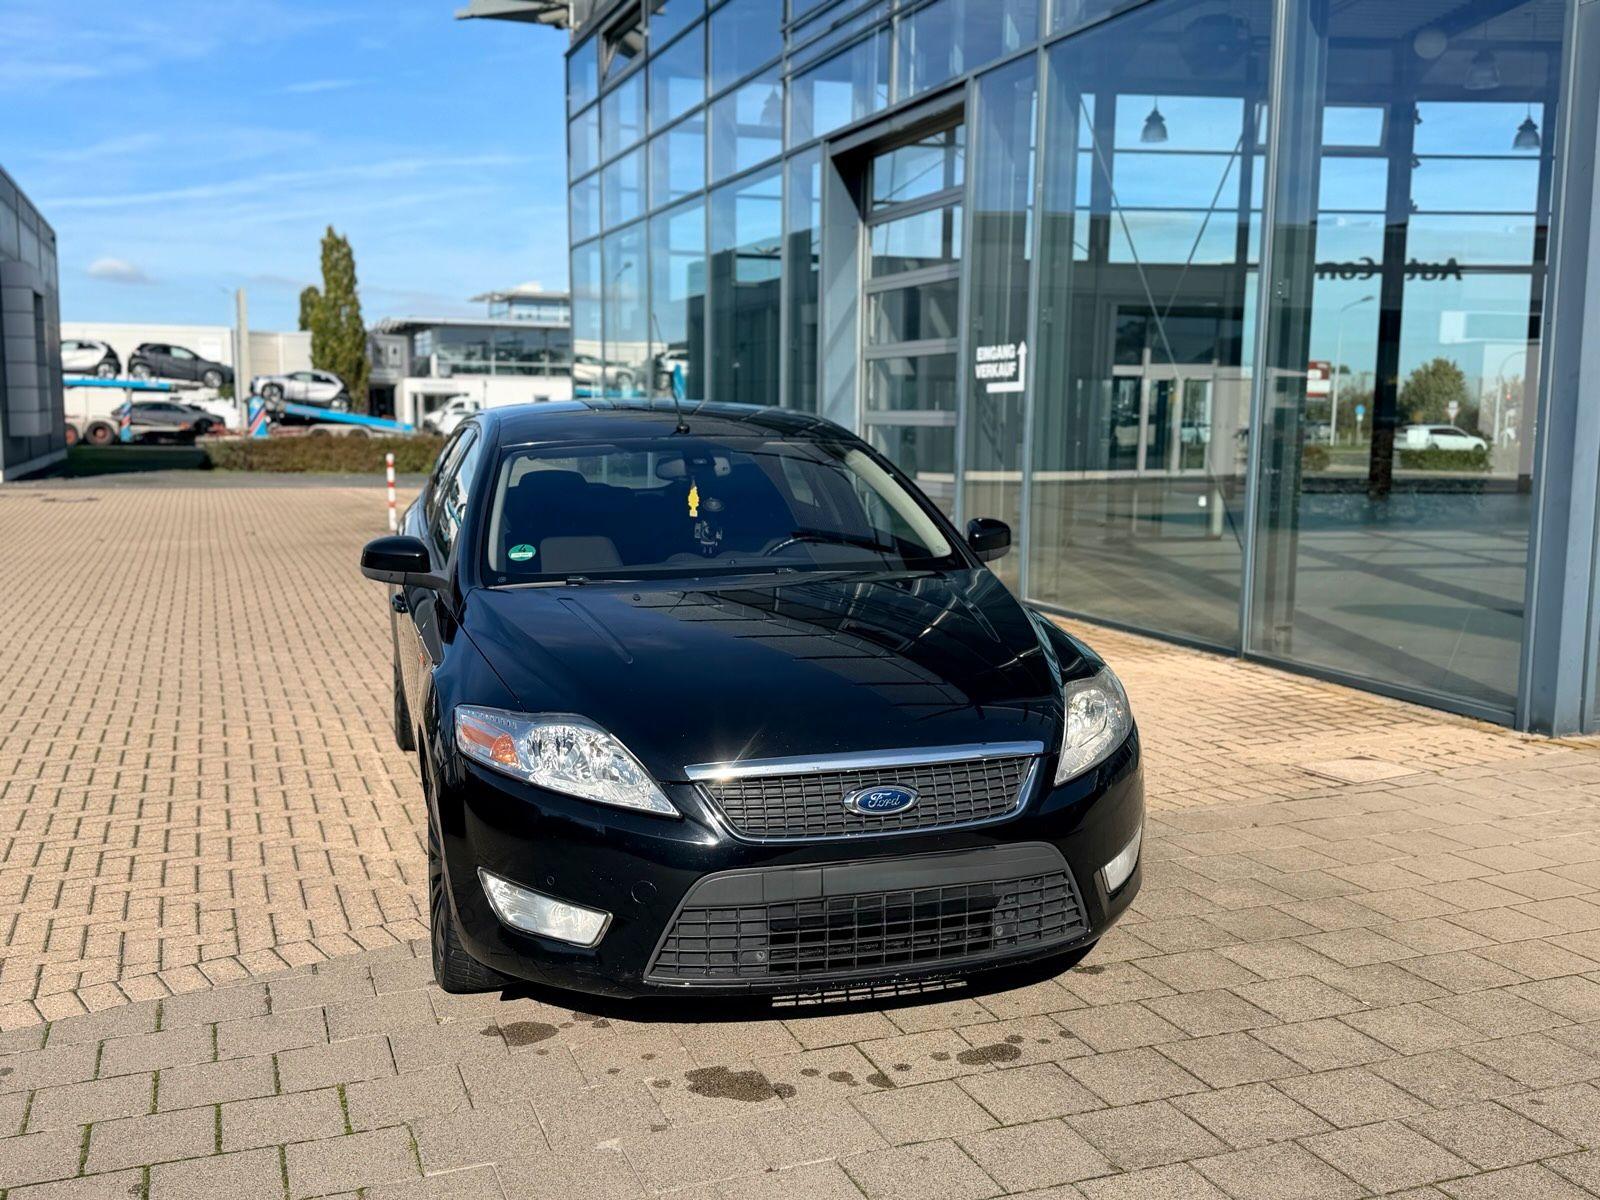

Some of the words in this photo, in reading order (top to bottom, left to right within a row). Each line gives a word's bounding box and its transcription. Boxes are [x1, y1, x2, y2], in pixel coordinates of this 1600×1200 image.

[976, 344, 1016, 362] EINGANG
[975, 362, 1017, 379] VERKAUF
[868, 792, 901, 808] Ford
